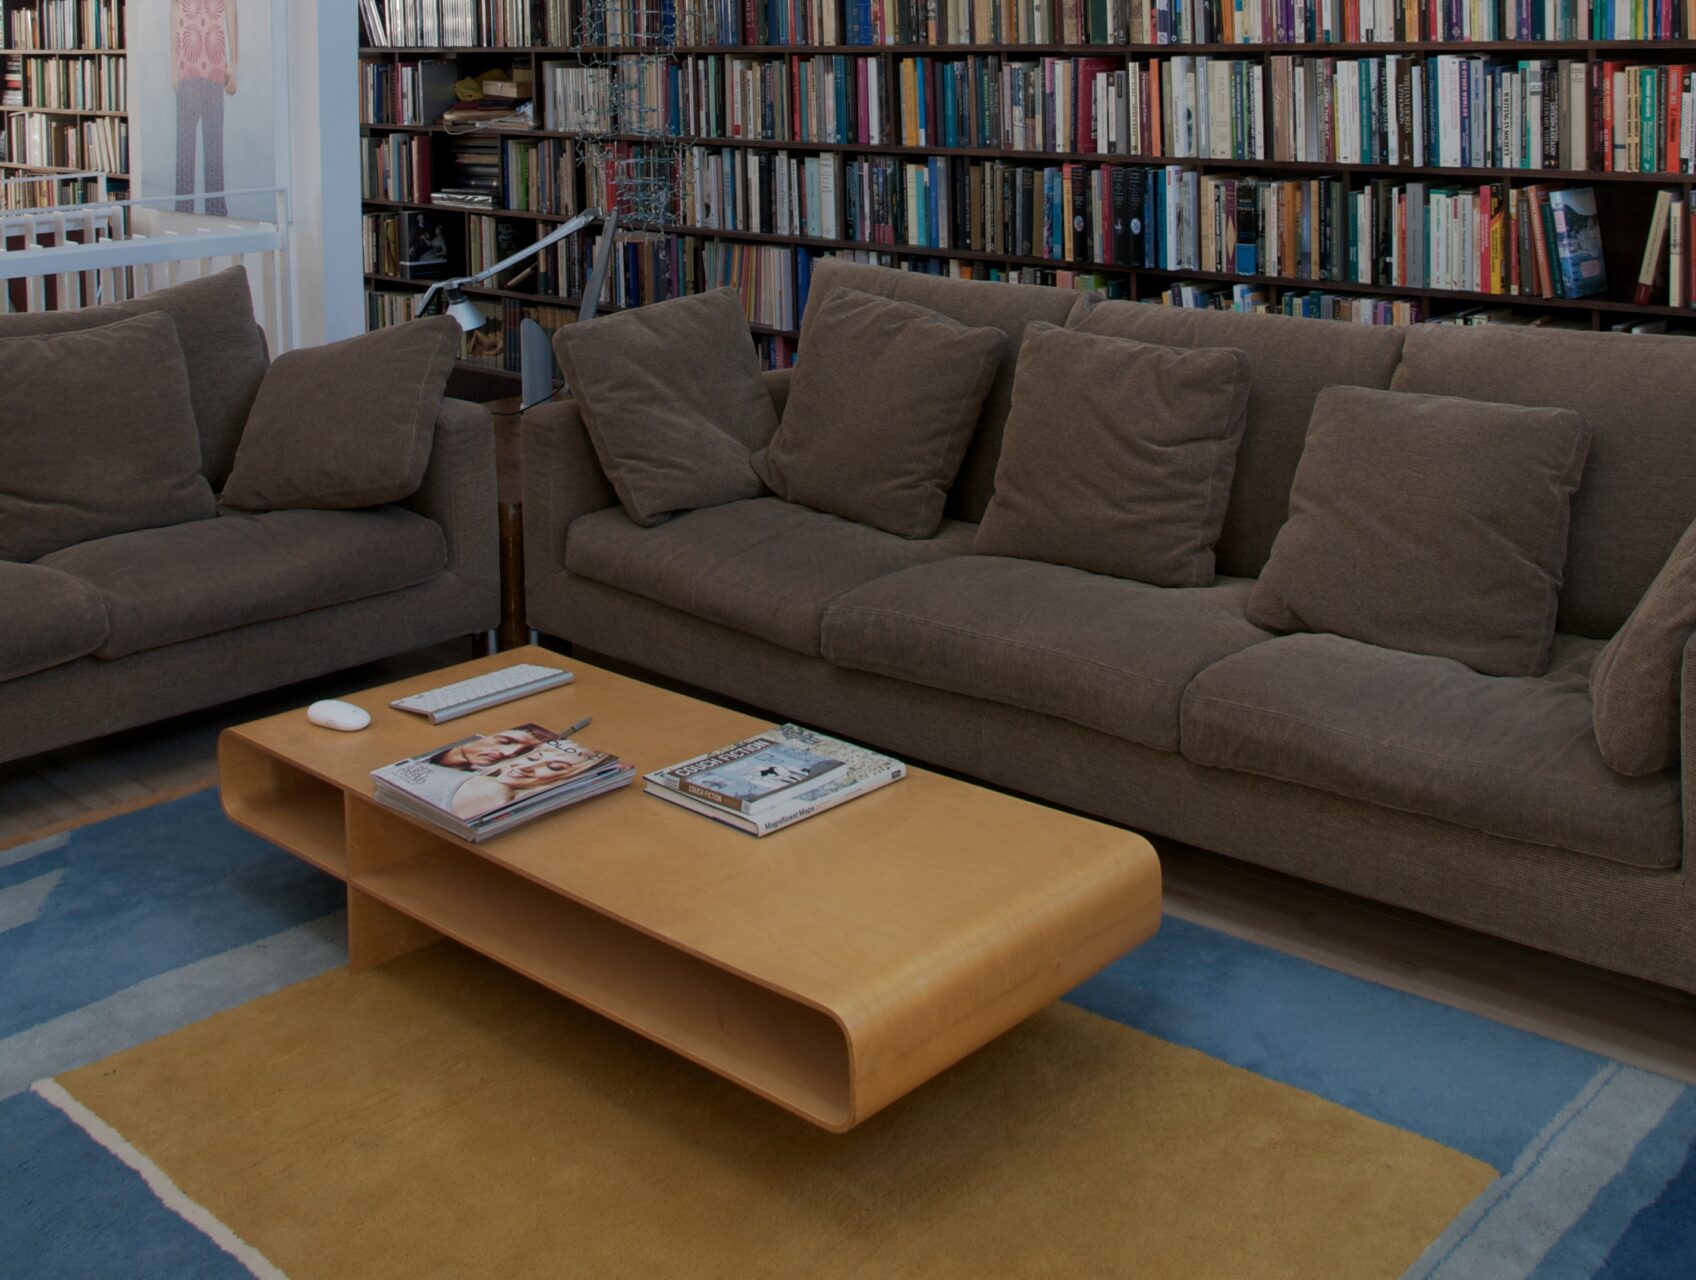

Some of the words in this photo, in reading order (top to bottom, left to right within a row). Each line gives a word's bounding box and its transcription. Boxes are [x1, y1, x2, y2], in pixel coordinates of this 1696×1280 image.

[675, 756, 719, 777] COUCH
[719, 739, 770, 762] FICTION
[688, 785, 705, 797] COUCH
[704, 790, 722, 803] FICTION
[764, 810, 798, 830] Magnificent
[799, 806, 815, 817] Maps
